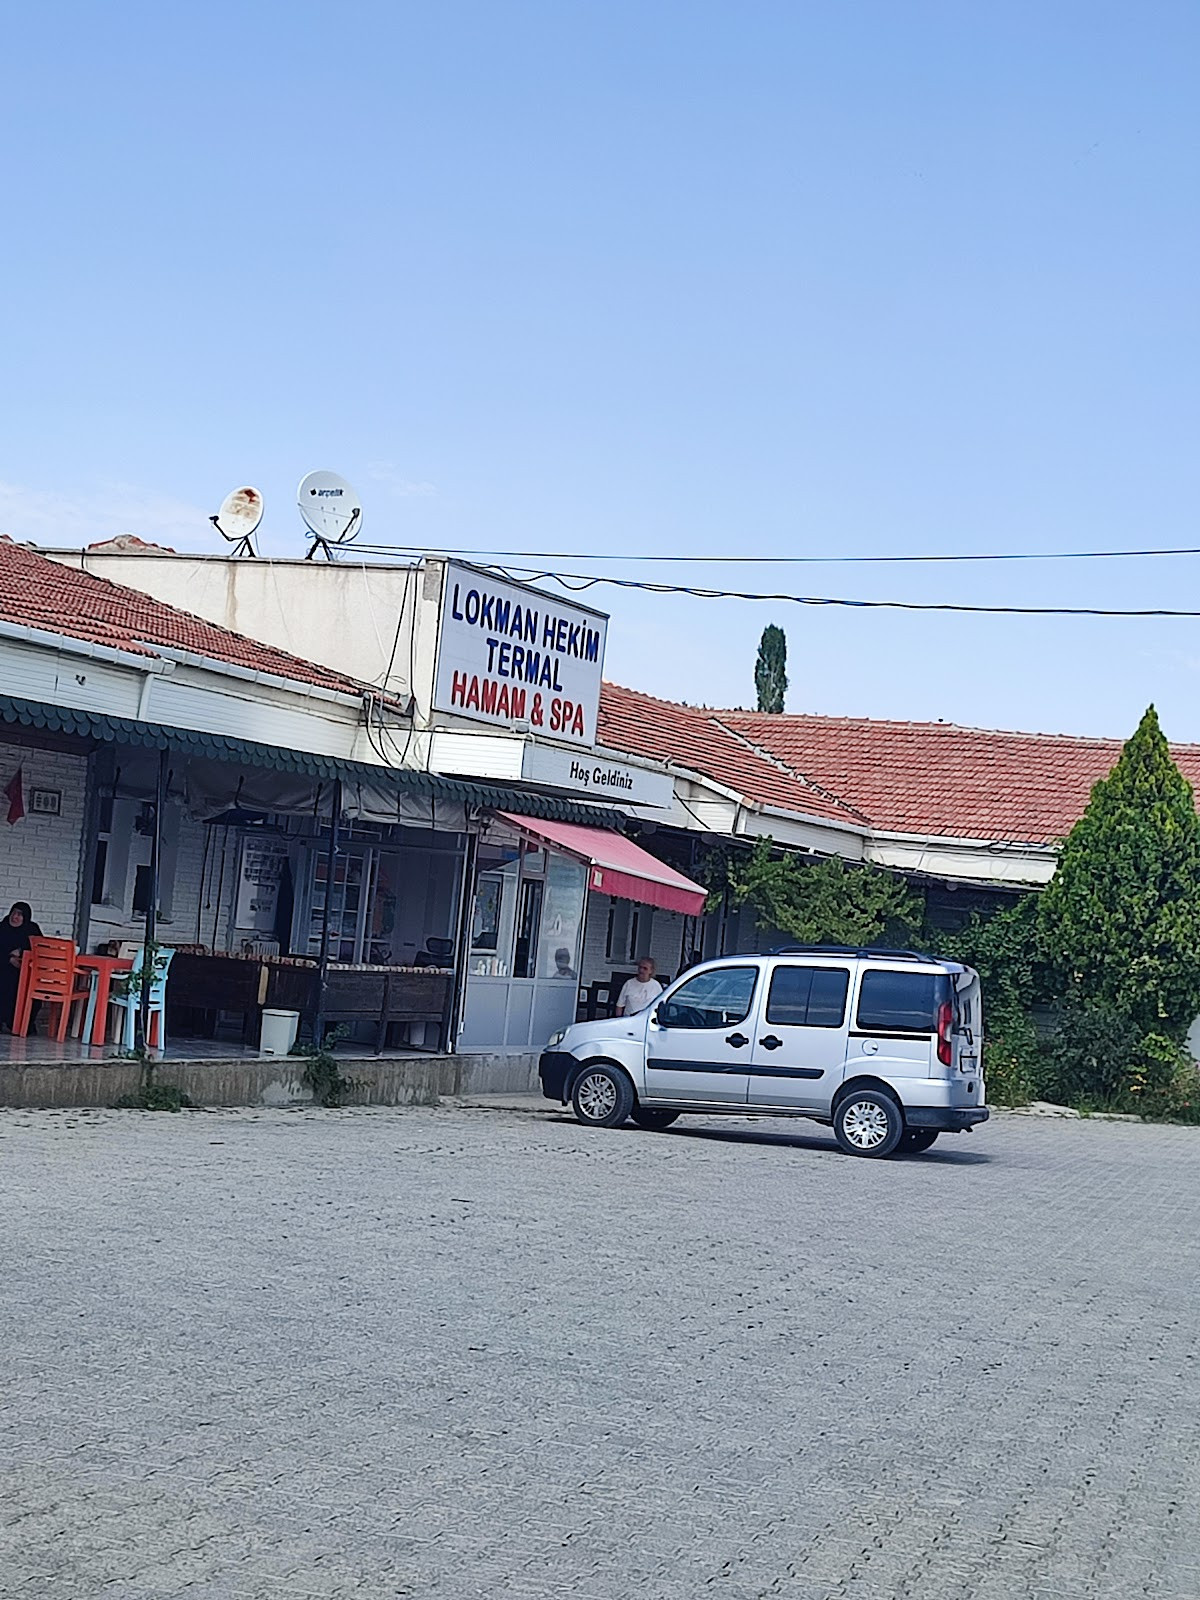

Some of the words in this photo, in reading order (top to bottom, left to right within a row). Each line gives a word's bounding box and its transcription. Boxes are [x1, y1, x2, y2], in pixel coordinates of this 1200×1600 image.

[452, 583, 538, 644] LOKMAN
[543, 615, 600, 662] HEKİM
[486, 638, 563, 692] TERMAL
[451, 670, 526, 719] HAMAM
[531, 693, 543, 727] &
[550, 698, 584, 737] SPA
[570, 761, 590, 786] Hoş
[593, 766, 633, 790] Geldiniz
